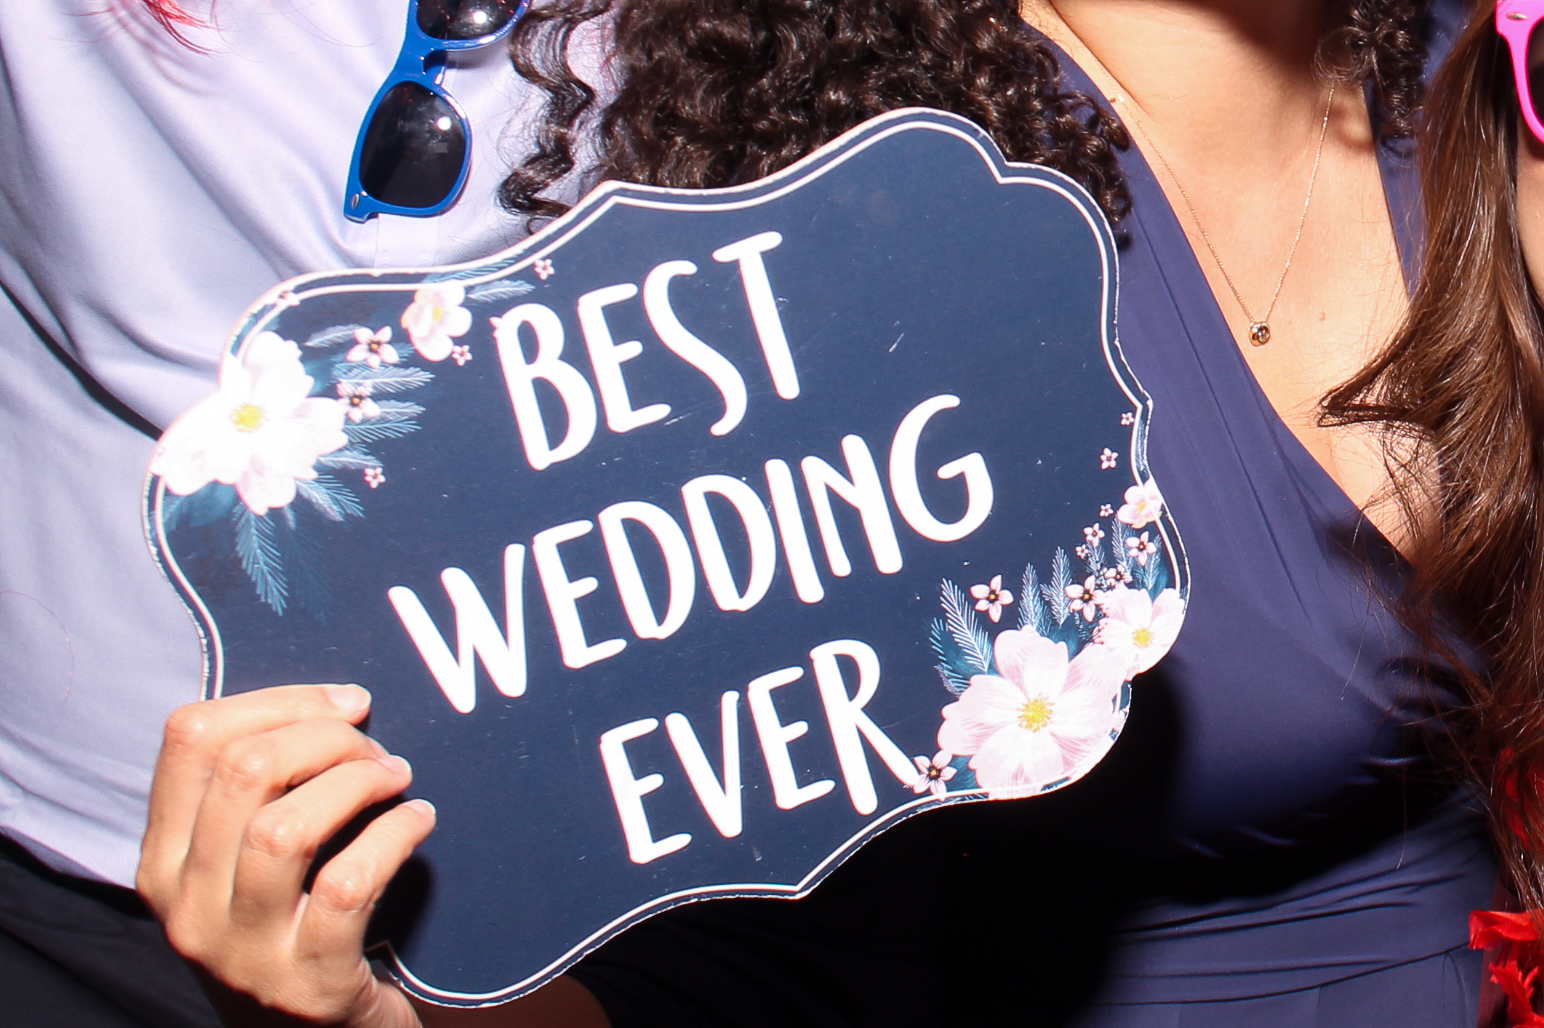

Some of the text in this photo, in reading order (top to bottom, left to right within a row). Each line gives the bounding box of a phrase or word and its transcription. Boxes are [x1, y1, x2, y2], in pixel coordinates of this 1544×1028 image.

[491, 231, 800, 470] BEST
[387, 394, 994, 714] WEDDING
[599, 639, 922, 864] EVER
